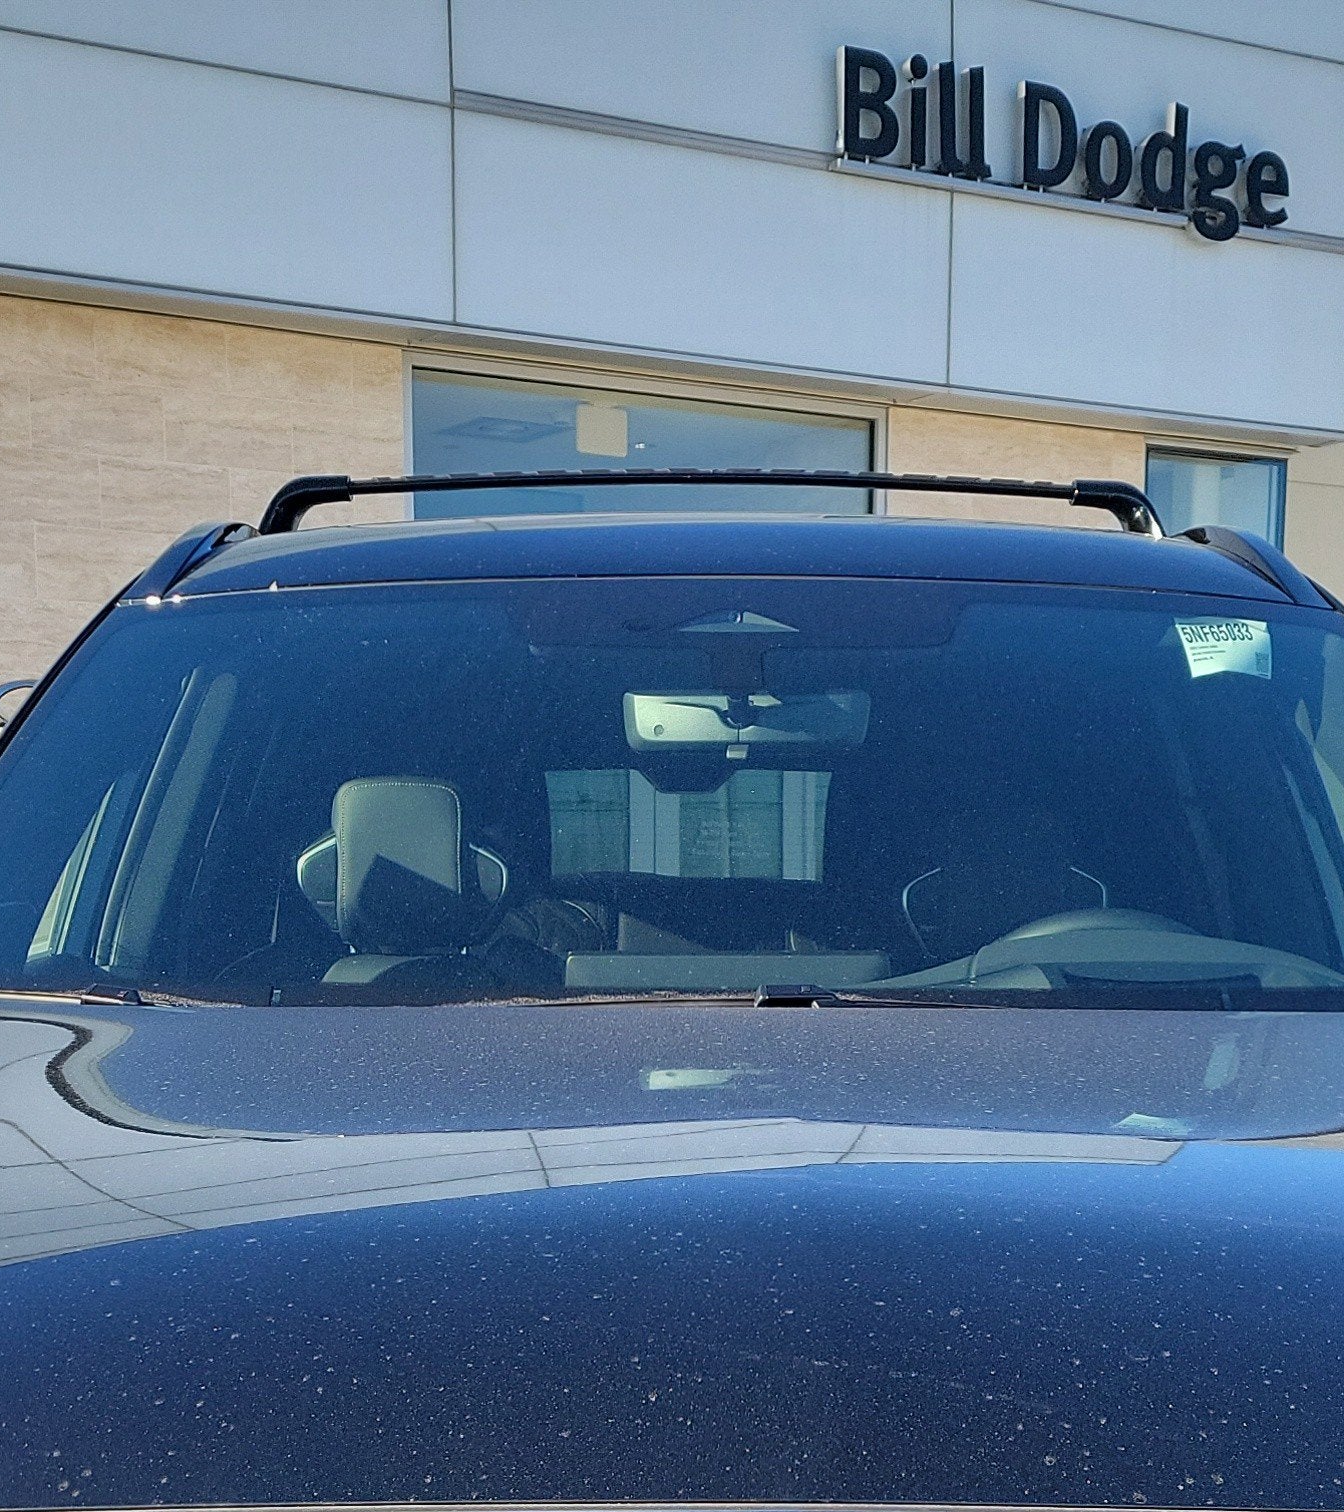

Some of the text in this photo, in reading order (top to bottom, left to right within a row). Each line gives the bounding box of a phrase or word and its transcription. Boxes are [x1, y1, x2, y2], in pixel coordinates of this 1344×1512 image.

[837, 45, 1289, 241] Bill Dodge
[1181, 623, 1253, 643] 5NF65033
